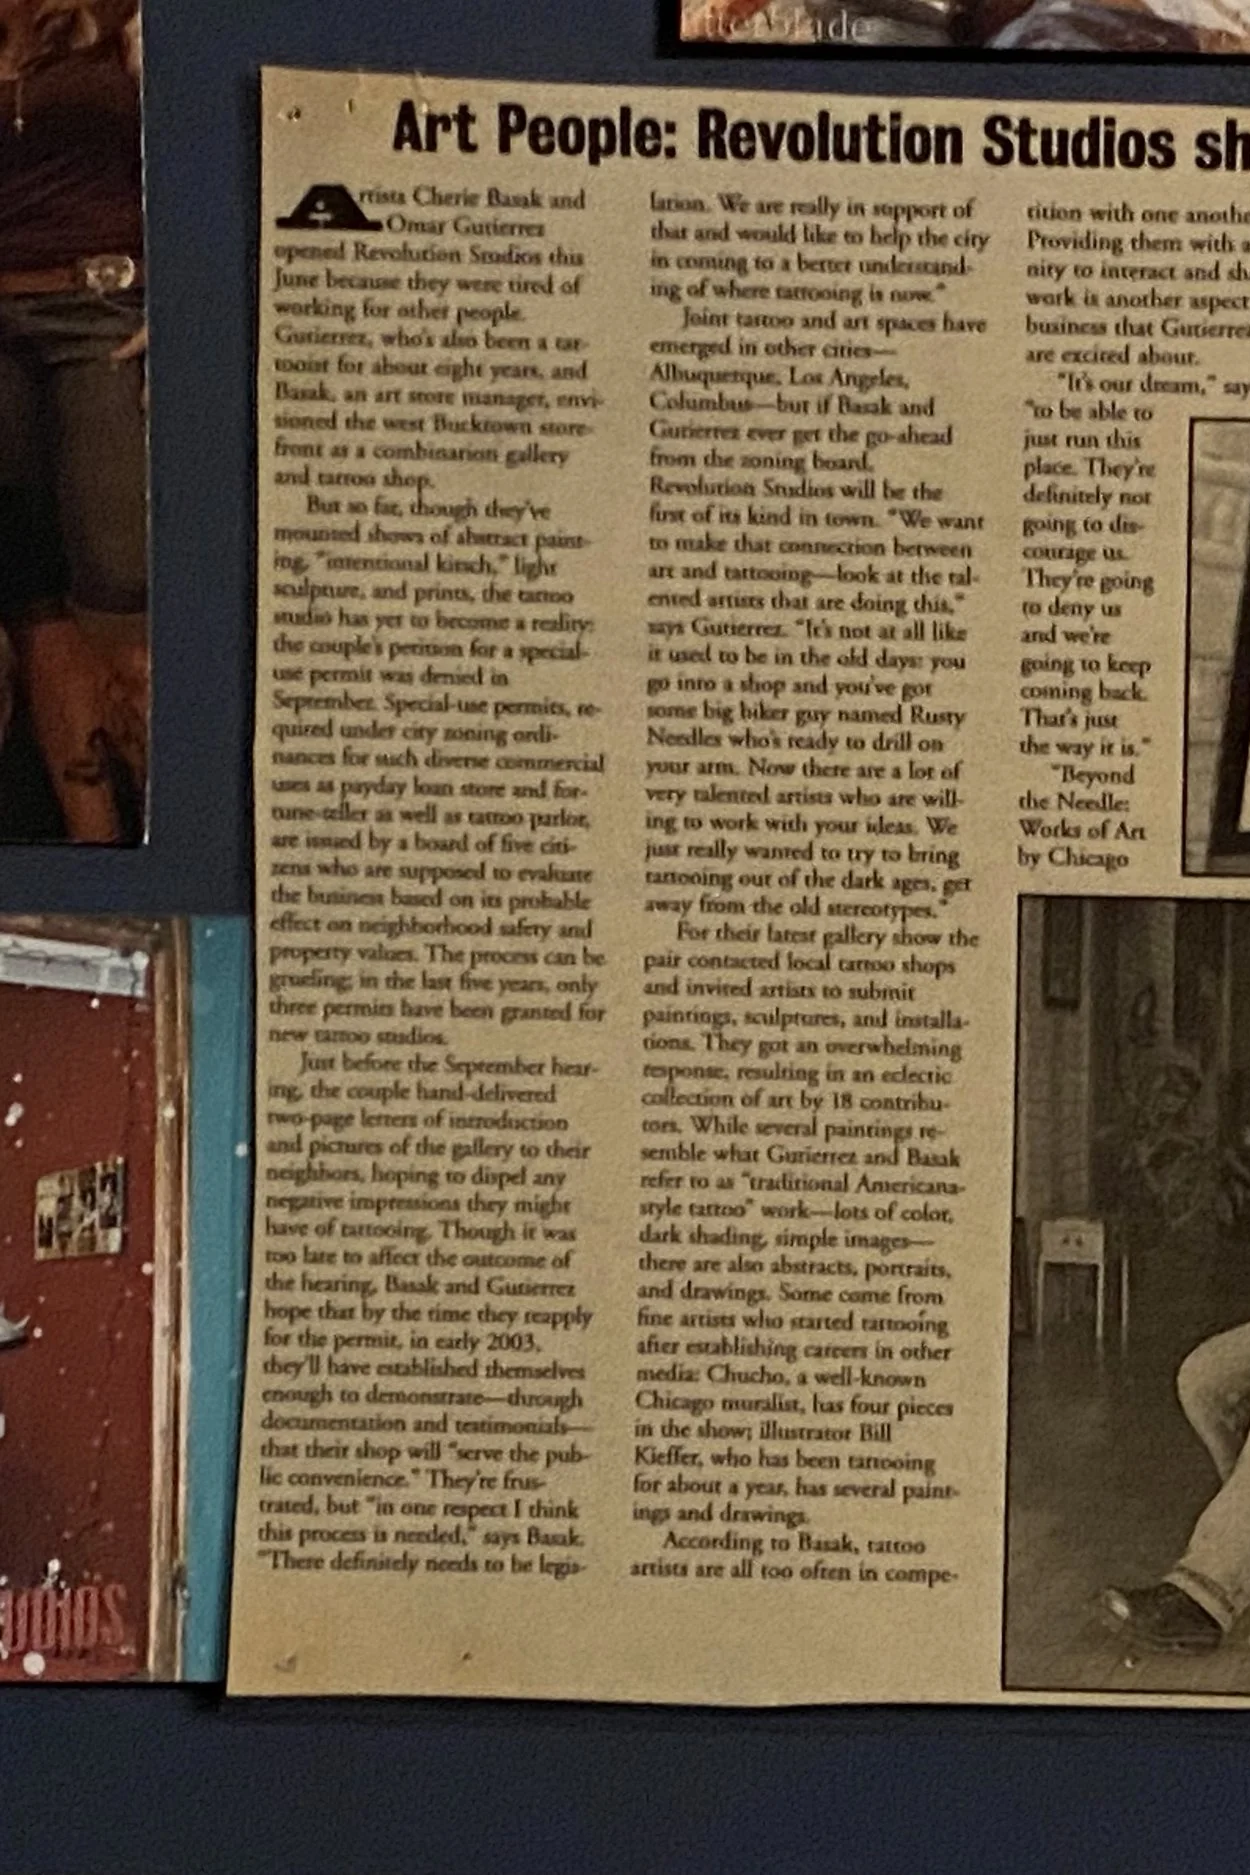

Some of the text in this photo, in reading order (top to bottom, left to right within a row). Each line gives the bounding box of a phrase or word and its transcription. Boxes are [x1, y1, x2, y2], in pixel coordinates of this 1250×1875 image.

[392, 100, 477, 152] Art
[499, 103, 677, 165] People:
[698, 107, 963, 165] Revolution
[982, 114, 1176, 169] Studios
[384, 213, 548, 237] Omar Gutierrez
[1026, 202, 1083, 220] tition
[1089, 202, 1135, 221] with
[1140, 210, 1179, 222] one
[649, 221, 991, 254] that and would like to help the city
[1026, 229, 1124, 257] Providing
[1130, 231, 1183, 251] them
[1189, 232, 1236, 252] with
[1025, 259, 1066, 284] nity
[1072, 262, 1094, 278] to
[1100, 261, 1177, 279] interact
[1183, 260, 1221, 280] and
[1025, 286, 1077, 306] work
[1082, 289, 1100, 307] is
[1105, 288, 1183, 308] another
[1189, 294, 1250, 317] aspect
[1025, 315, 1108, 336] business
[1114, 317, 1155, 336] that
[1024, 350, 1056, 363] are
[1060, 344, 1131, 364] excited
[1098, 379, 1133, 392] our
[1022, 429, 1143, 455] just run this
[1022, 483, 1153, 511] definitely not
[1021, 513, 1077, 539] going
[1082, 517, 1104, 532] to
[1019, 623, 1114, 644] and we're
[1019, 654, 1153, 680] going to keep
[1019, 681, 1094, 707] coming
[1018, 734, 1051, 754] the
[1056, 742, 1094, 762] way
[1099, 739, 1114, 756] it
[1017, 790, 1051, 810] the
[1019, 817, 1148, 840] Works of Art
[1016, 844, 1131, 874] by Chicago
[637, 1251, 687, 1271] there
[692, 1260, 722, 1272] are
[726, 1253, 765, 1273] also
[262, 1326, 292, 1346] for
[296, 1327, 328, 1347] the
[409, 1332, 430, 1349] in
[434, 1331, 480, 1358] early
[634, 1389, 715, 1417] Chicago
[812, 1393, 845, 1413] has
[849, 1394, 890, 1414] four
[896, 1397, 955, 1422] pieces
[633, 1419, 654, 1437] in
[660, 1418, 692, 1437] the
[759, 1420, 852, 1441] illustrator
[859, 1422, 894, 1442] Bill
[259, 1437, 300, 1457] that
[304, 1438, 350, 1458] their
[354, 1439, 402, 1466] shop
[407, 1440, 443, 1460] will
[508, 1442, 540, 1462] the
[710, 1447, 753, 1467] who
[757, 1448, 790, 1467] has
[795, 1448, 841, 1468] been
[847, 1451, 937, 1477] tattooing
[662, 1530, 764, 1558] According
[770, 1536, 791, 1551] to
[866, 1538, 928, 1554] tattoo
